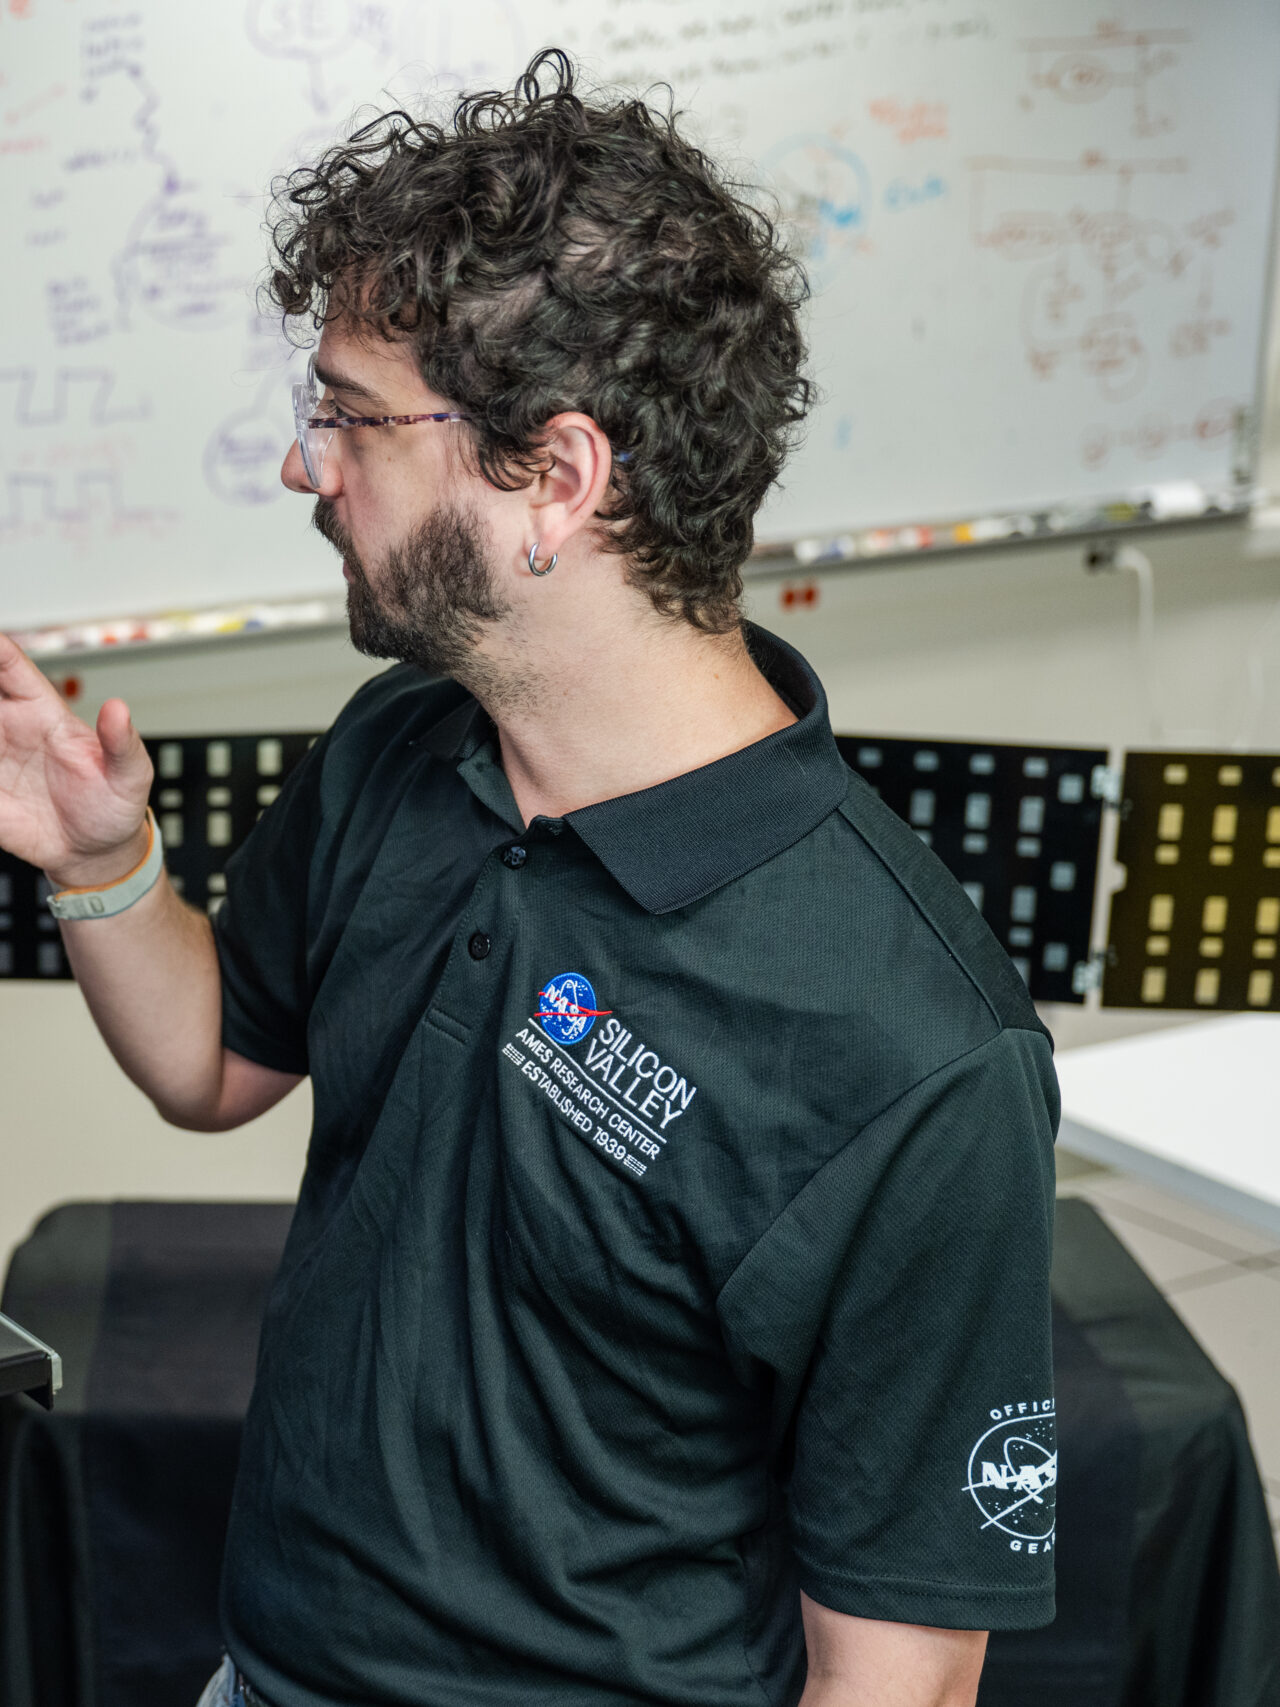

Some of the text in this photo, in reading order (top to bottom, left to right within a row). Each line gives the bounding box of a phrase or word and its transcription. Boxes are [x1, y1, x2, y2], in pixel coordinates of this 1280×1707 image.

[544, 984, 588, 1034] NASA
[515, 1027, 661, 1160] AMES RESEARCH CENTER
[584, 1038, 683, 1130] VALLEY
[599, 1018, 697, 1110] SILICON
[521, 1061, 627, 1161] ESTABLISHED 1939
[981, 1461, 1057, 1490] NAS
